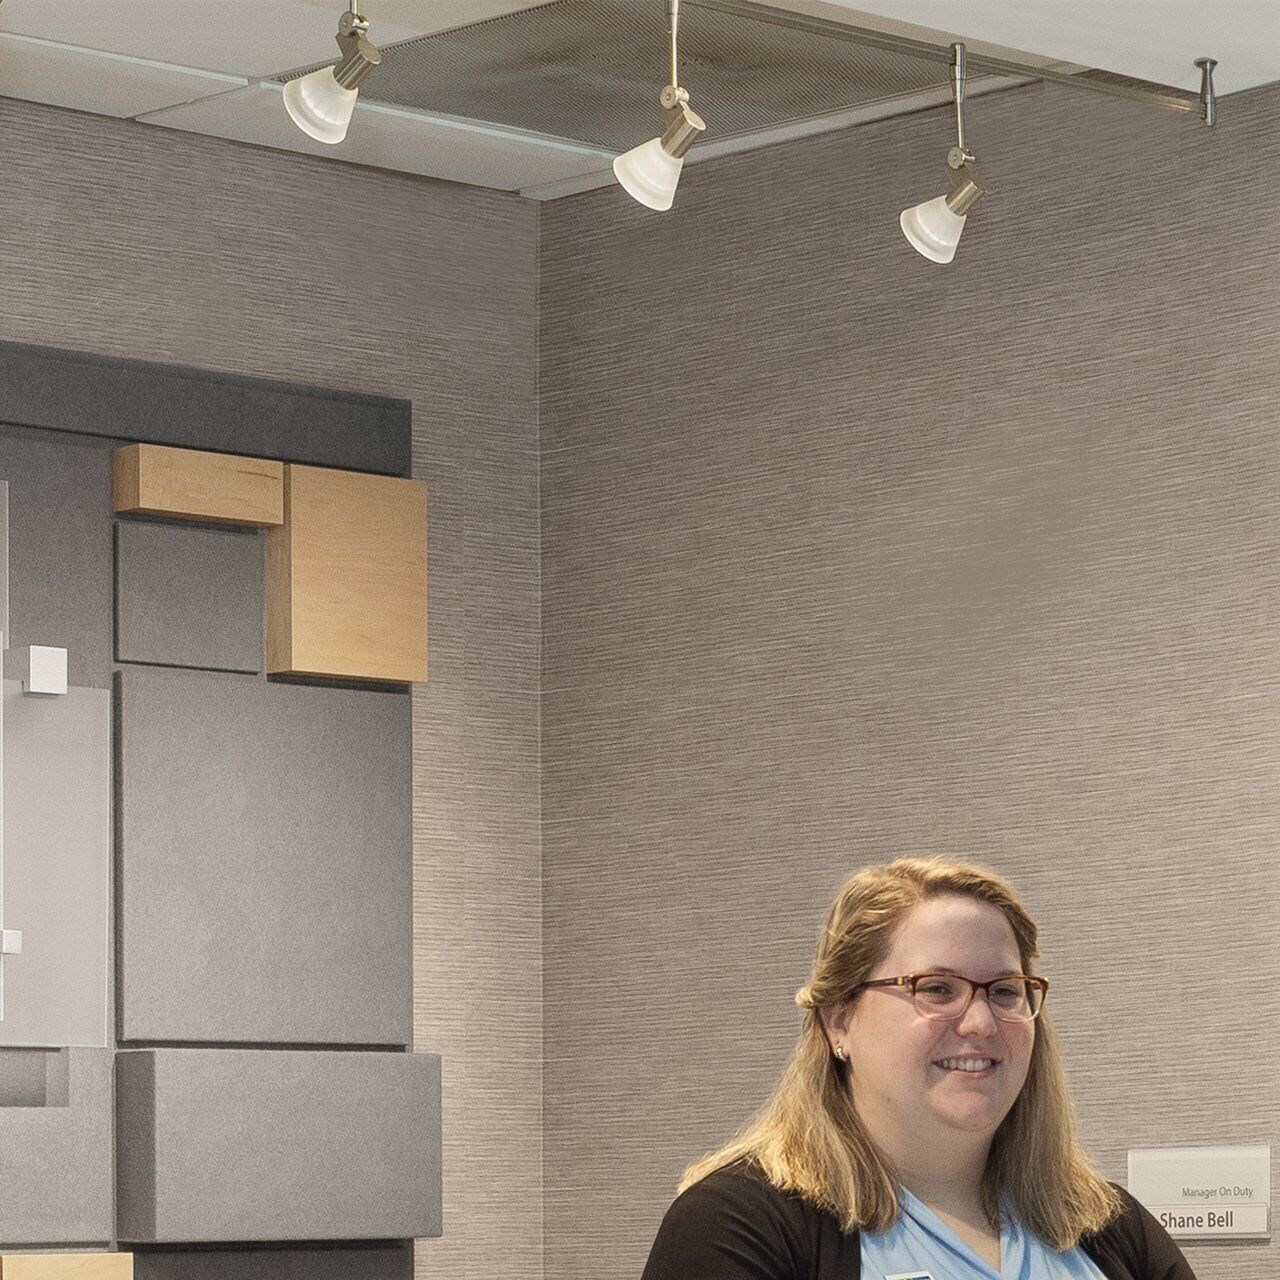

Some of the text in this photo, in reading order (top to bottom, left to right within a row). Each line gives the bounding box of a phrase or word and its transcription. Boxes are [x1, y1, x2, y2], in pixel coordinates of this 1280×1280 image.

[1181, 1185, 1254, 1199] Manager On Duty
[1160, 1210, 1234, 1229] Shane Bell
